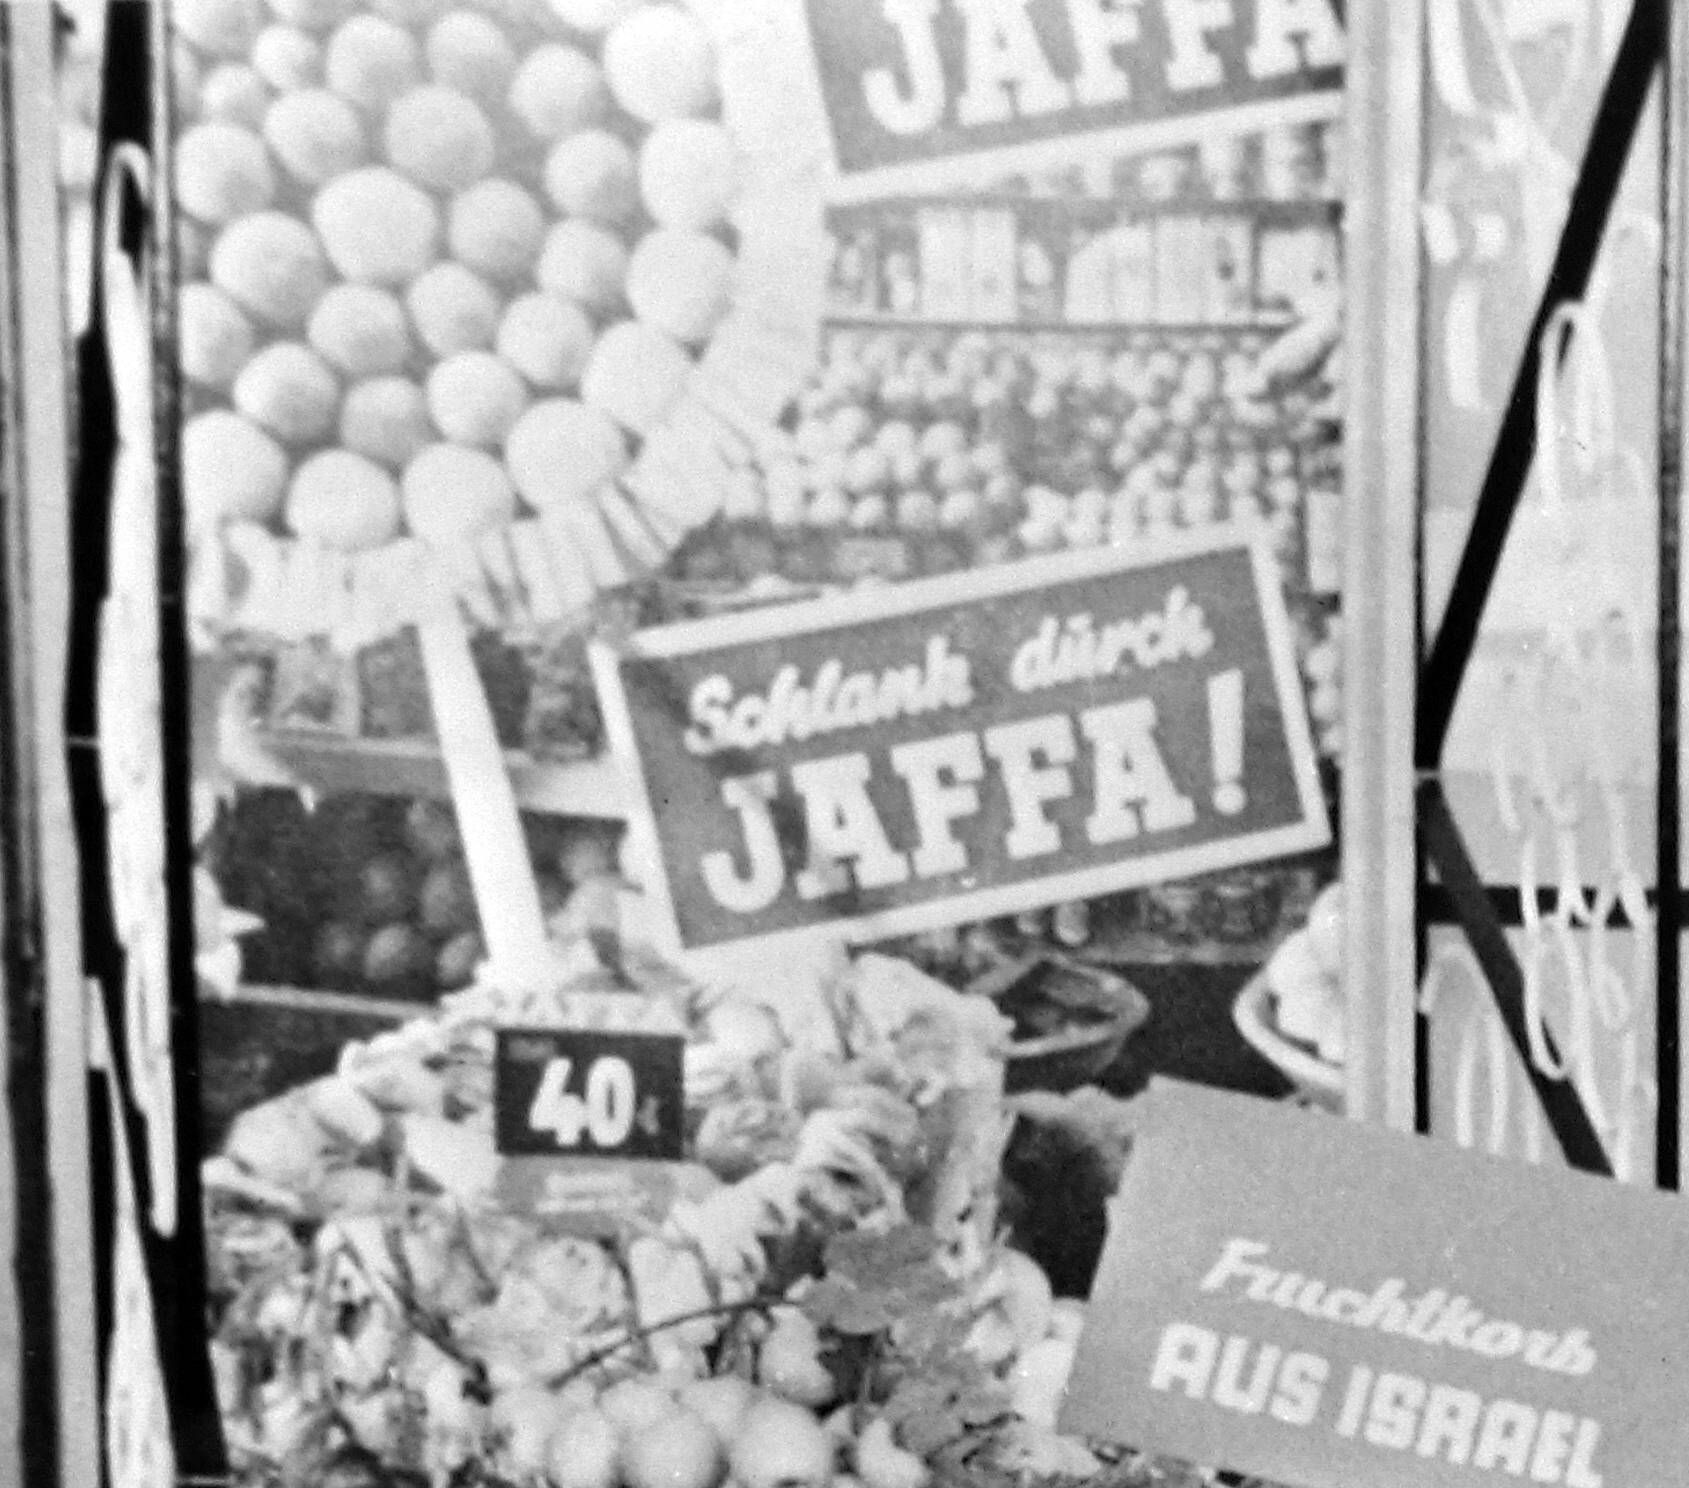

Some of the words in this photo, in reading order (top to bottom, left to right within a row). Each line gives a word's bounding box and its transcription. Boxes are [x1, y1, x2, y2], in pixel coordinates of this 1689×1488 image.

[861, 0, 1346, 134] JAFFA
[684, 634, 974, 756] Schlank
[702, 668, 1246, 912] JAFFA!
[1150, 1323, 1329, 1425] AUS
[1202, 1238, 1597, 1376] Fruchtkorb
